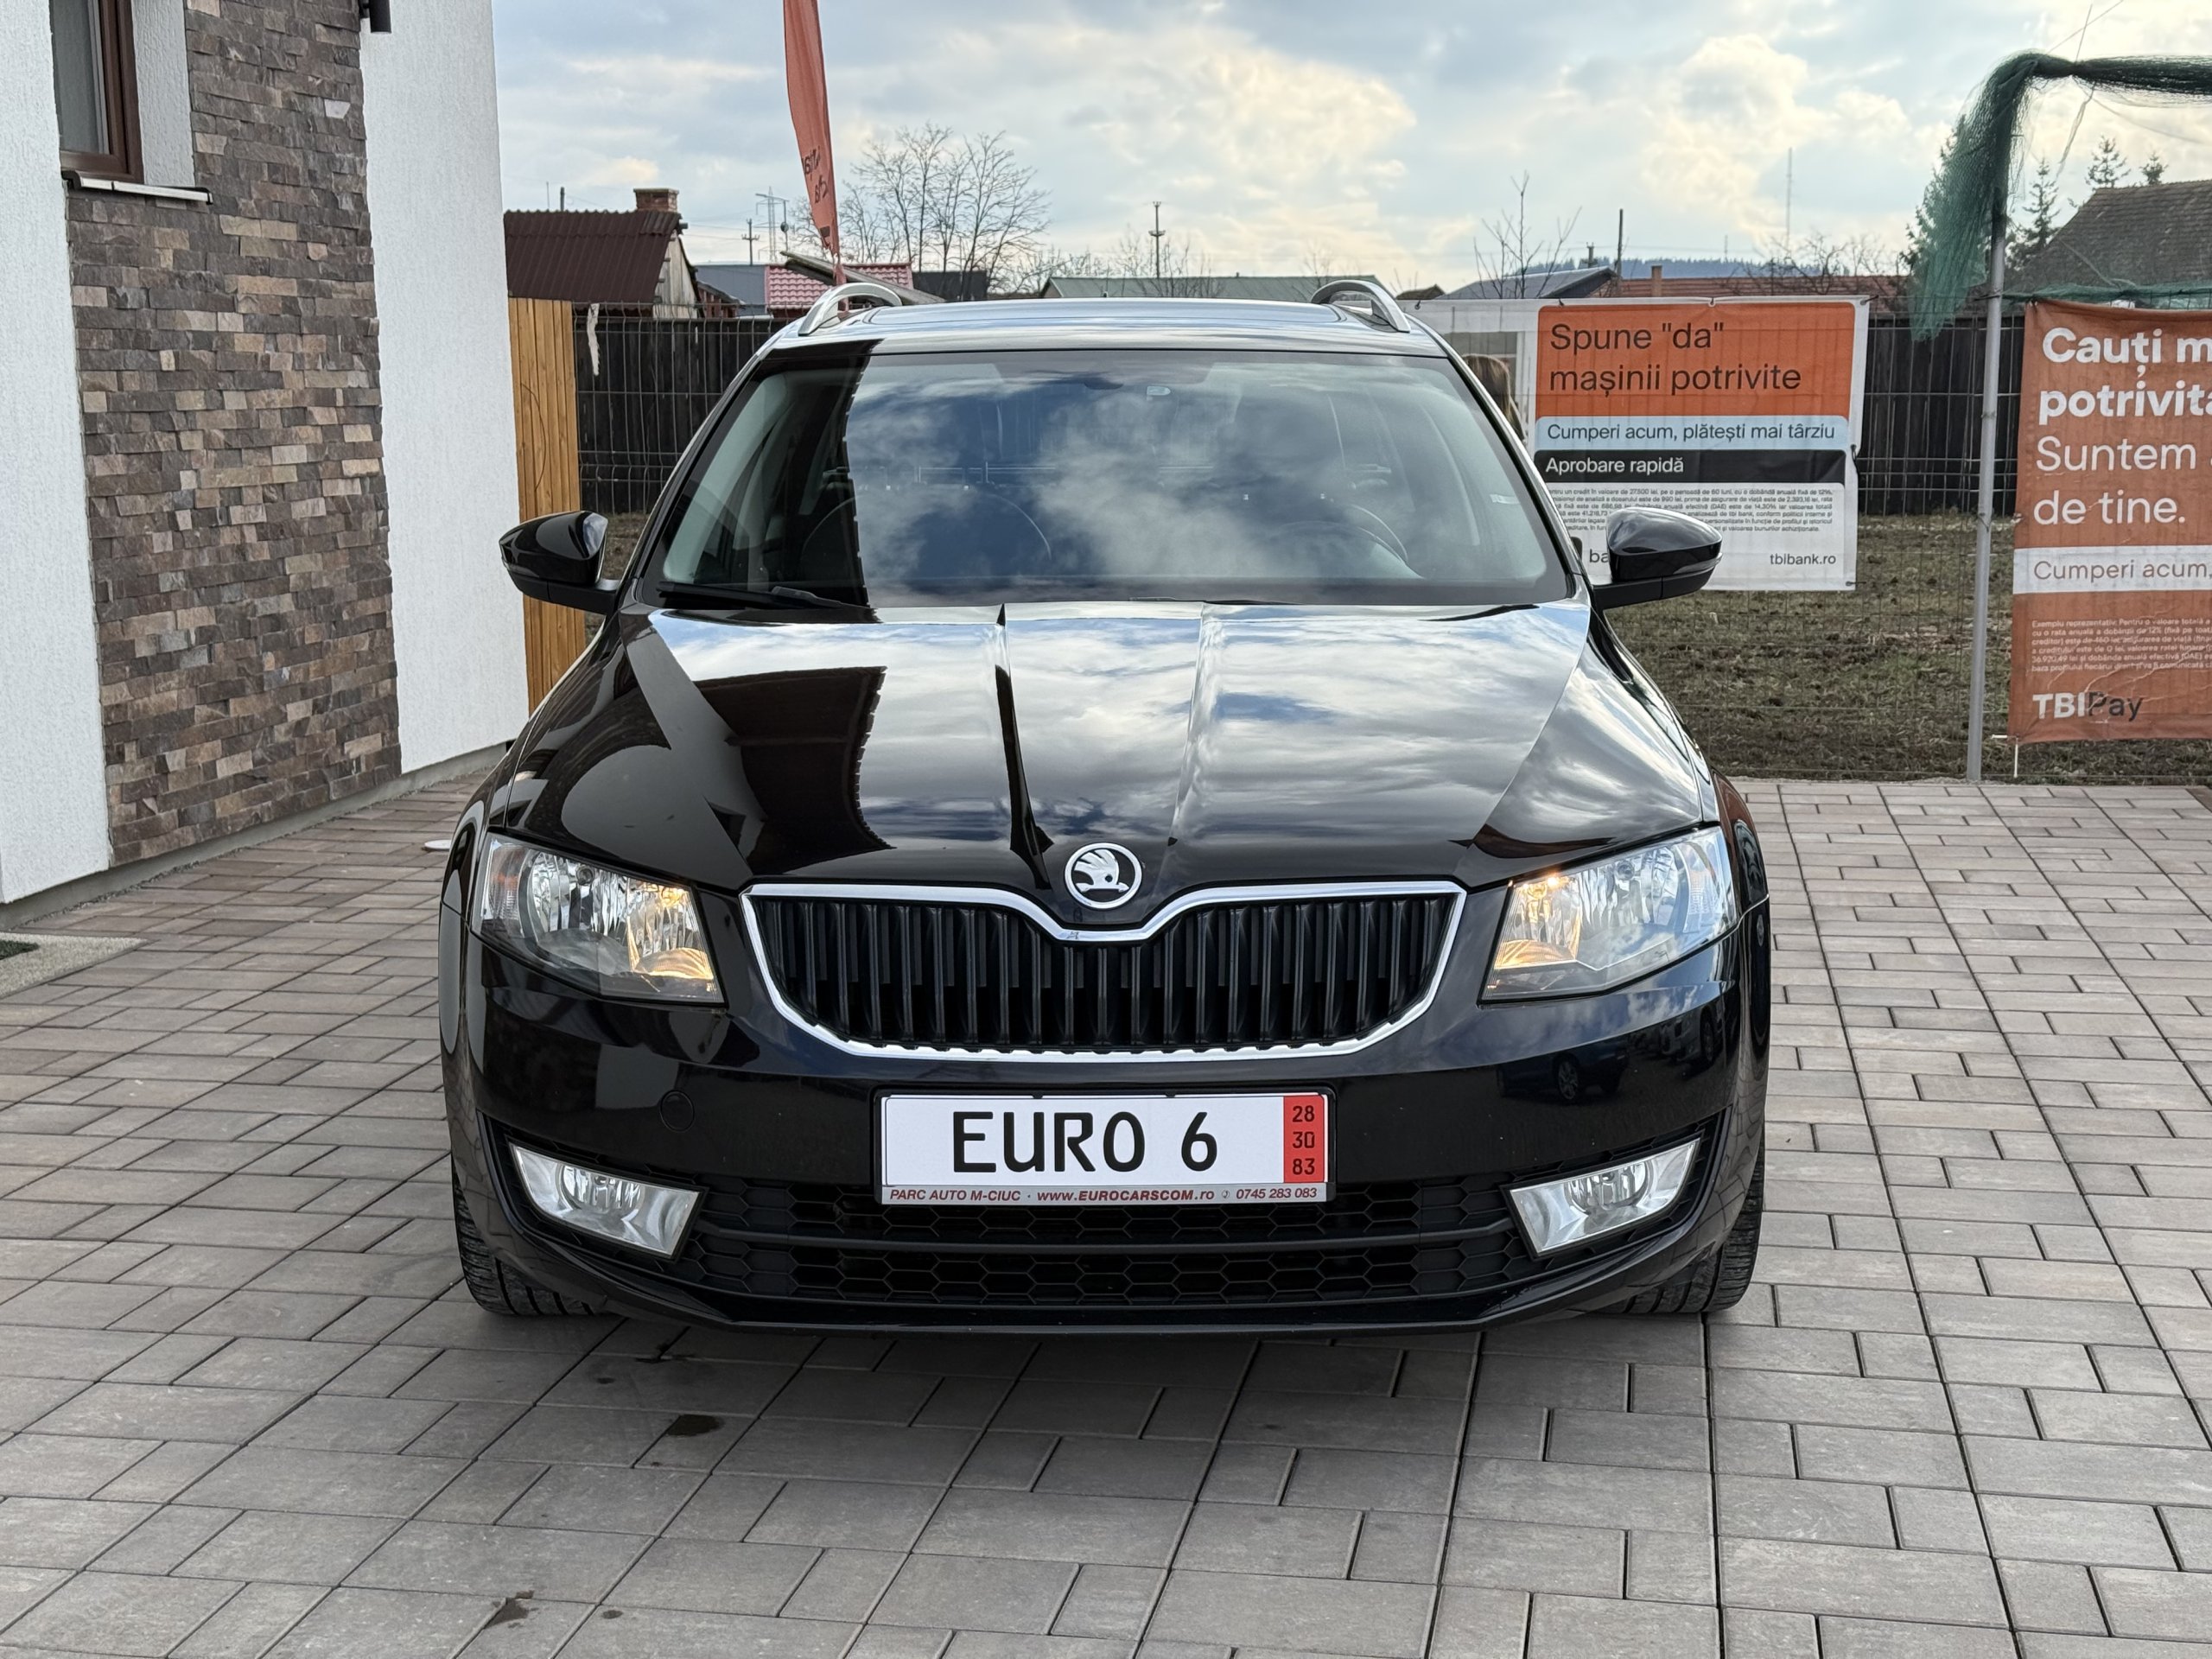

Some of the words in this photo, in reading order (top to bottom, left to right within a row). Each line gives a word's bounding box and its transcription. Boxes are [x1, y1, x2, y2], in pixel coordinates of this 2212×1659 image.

[1550, 322, 1652, 355] Spune
[1662, 321, 1725, 349] "da"
[2042, 327, 2162, 378] Cauți
[1549, 364, 1661, 397] mașinii
[1671, 363, 1802, 396] potrivite
[1548, 423, 1620, 442] Cumperi
[1625, 426, 1678, 442] acum,
[1682, 423, 1745, 442] plătești
[1751, 423, 1783, 439] mai
[1788, 422, 1835, 439] târziu
[1545, 457, 1625, 476] Aprobare
[1630, 456, 1684, 476] rapidă
[2036, 435, 2196, 473] Suntem
[2033, 490, 2086, 526] de
[2098, 488, 2186, 525] tine.
[1590, 548, 1610, 563] ba
[1770, 553, 1837, 565] tbibank.ro
[2033, 559, 2135, 583] Cumperi
[2032, 691, 2144, 722] TBIPay
[1292, 1105, 1315, 1122] 28
[953, 1111, 1146, 1173] EURO
[1180, 1111, 1217, 1173] 6
[1292, 1131, 1315, 1148] 30
[1292, 1158, 1315, 1175] 83
[890, 1189, 926, 1200] PARC
[929, 1189, 968, 1201] AUTO
[970, 1190, 1021, 1201] M-CIUC
[1037, 1189, 1214, 1202] www.EUROCARSCOM.ro
[1236, 1188, 1267, 1199] 0745
[1268, 1188, 1292, 1199] 283
[1294, 1187, 1318, 1198] 083
